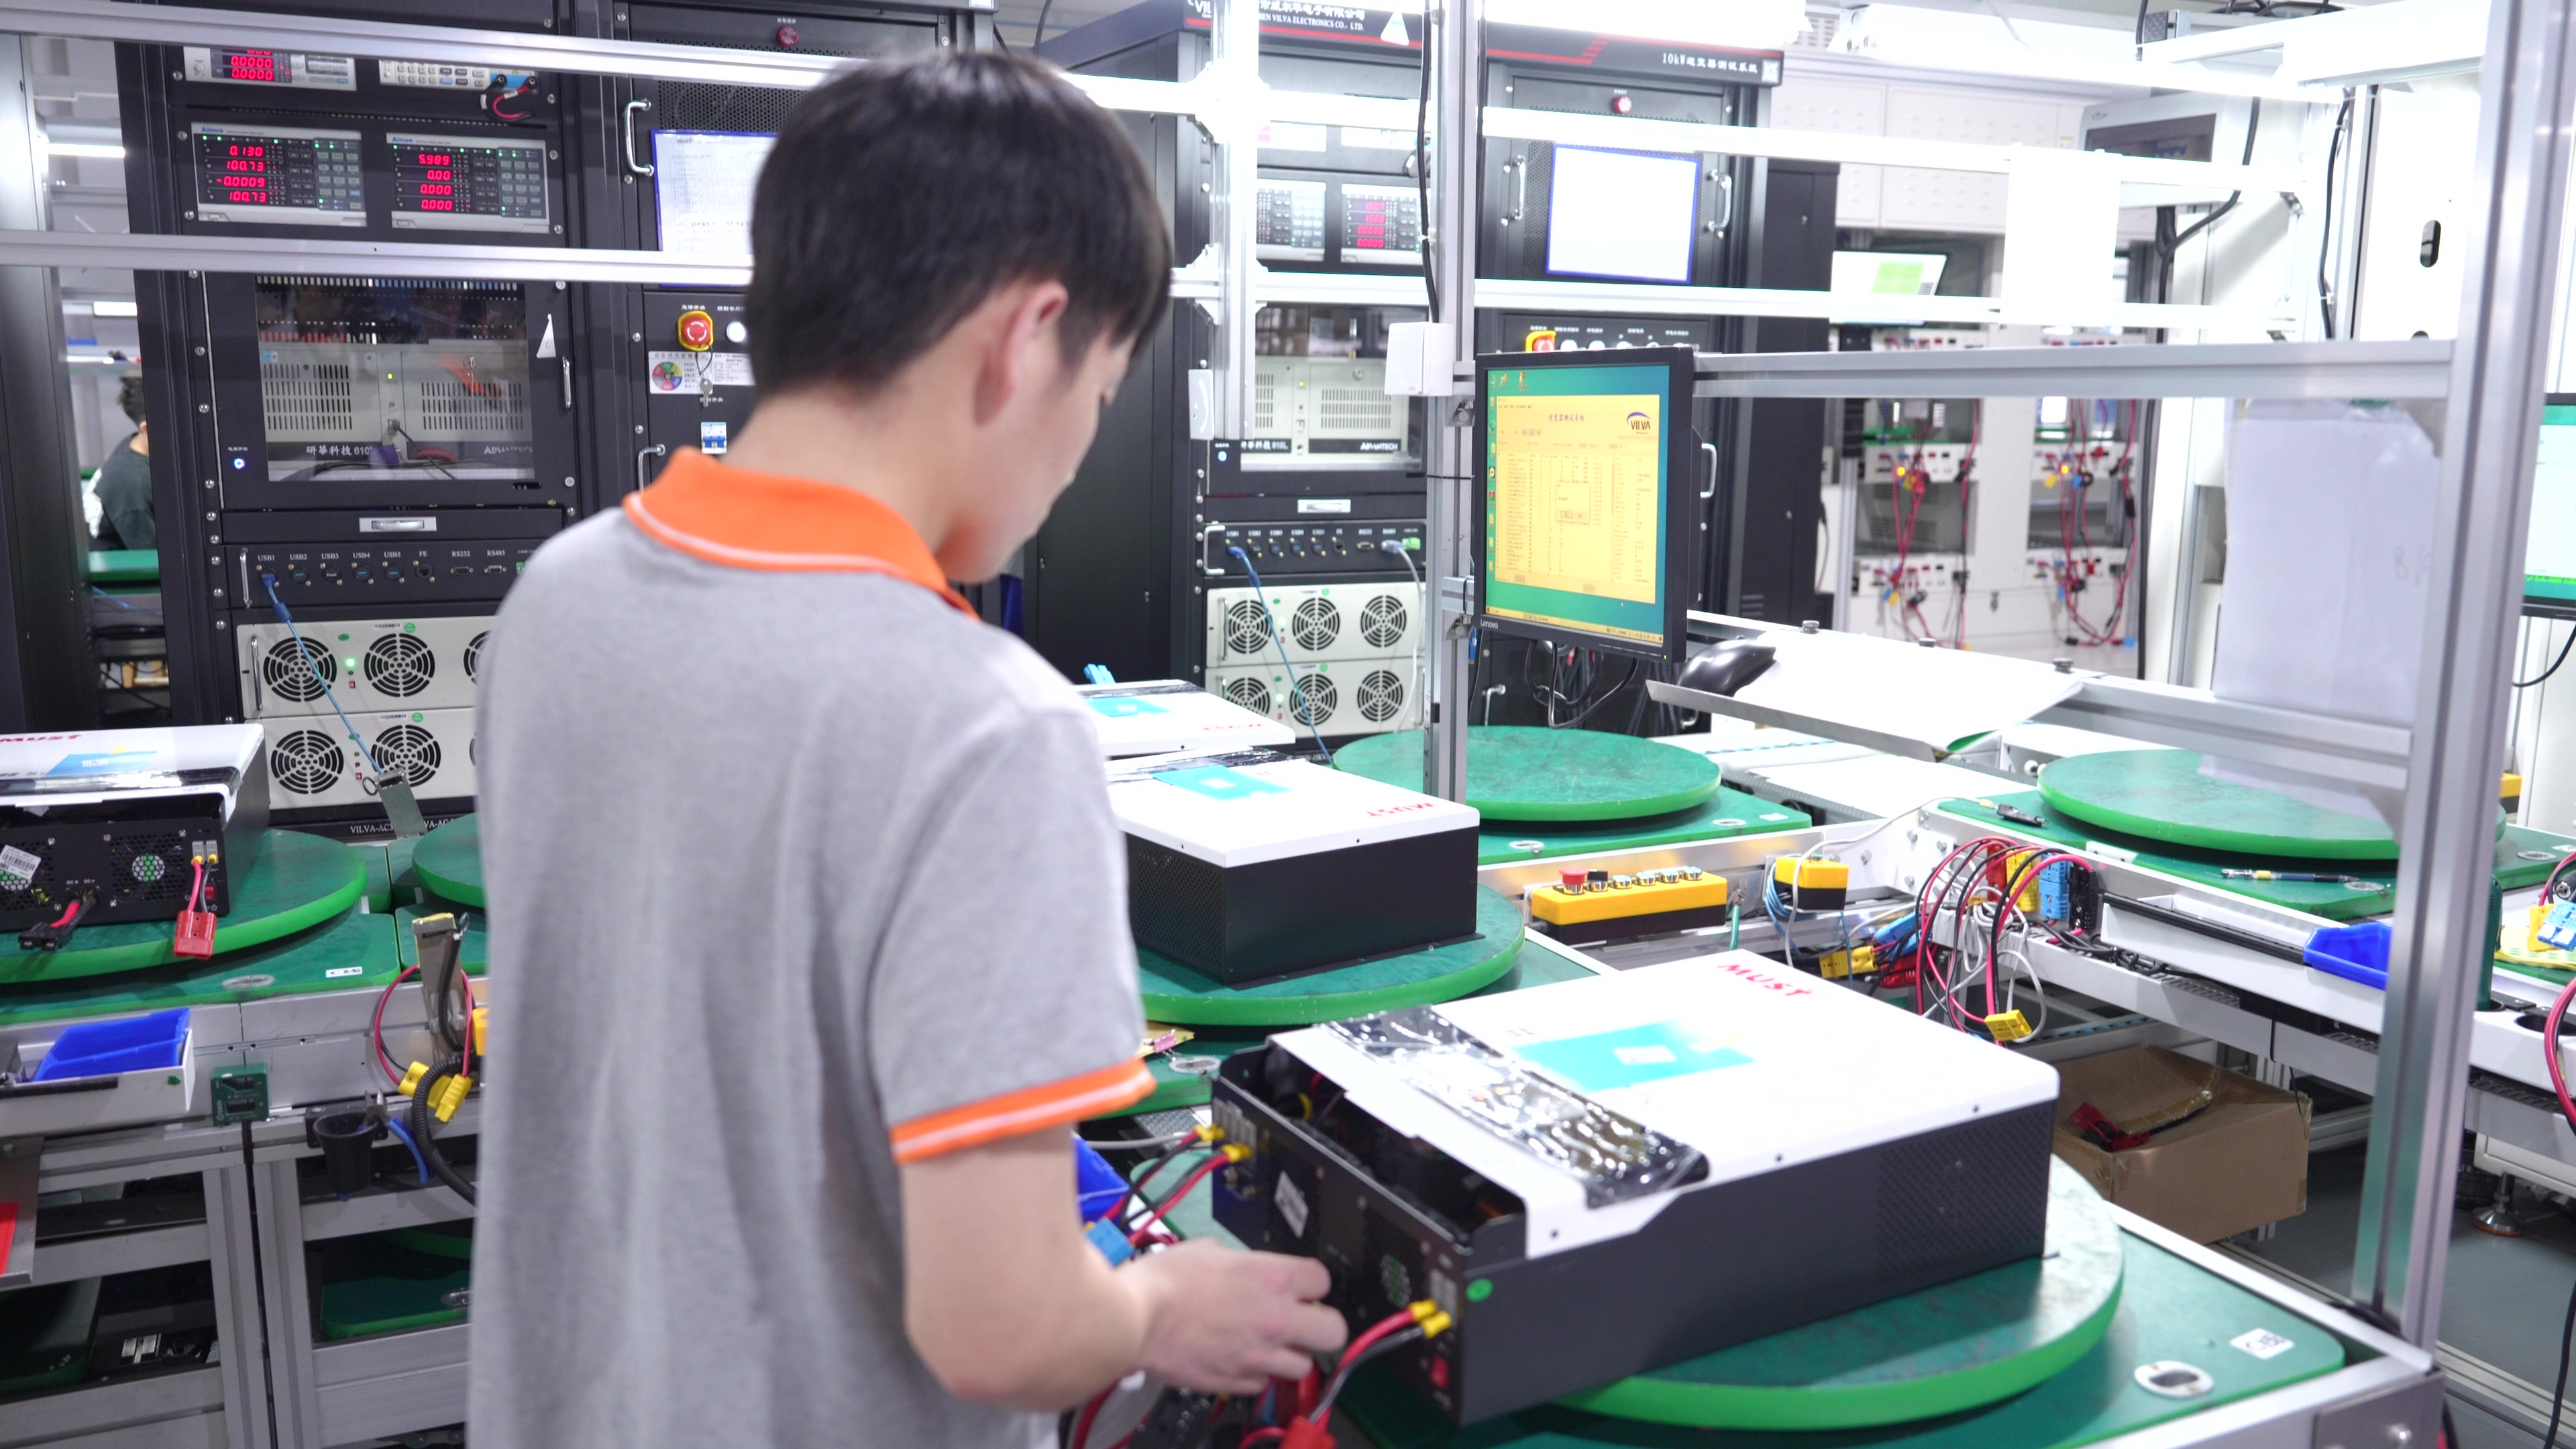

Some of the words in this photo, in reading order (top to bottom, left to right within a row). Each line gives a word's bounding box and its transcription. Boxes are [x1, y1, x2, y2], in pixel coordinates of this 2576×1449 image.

[1273, 15, 1292, 23] VILVA
[1293, 16, 1334, 28] ELECTRONICS
[1481, 619, 1499, 629] Lenovo
[350, 822, 393, 834] VILVA-AC3
[1717, 965, 1813, 996] MUST
